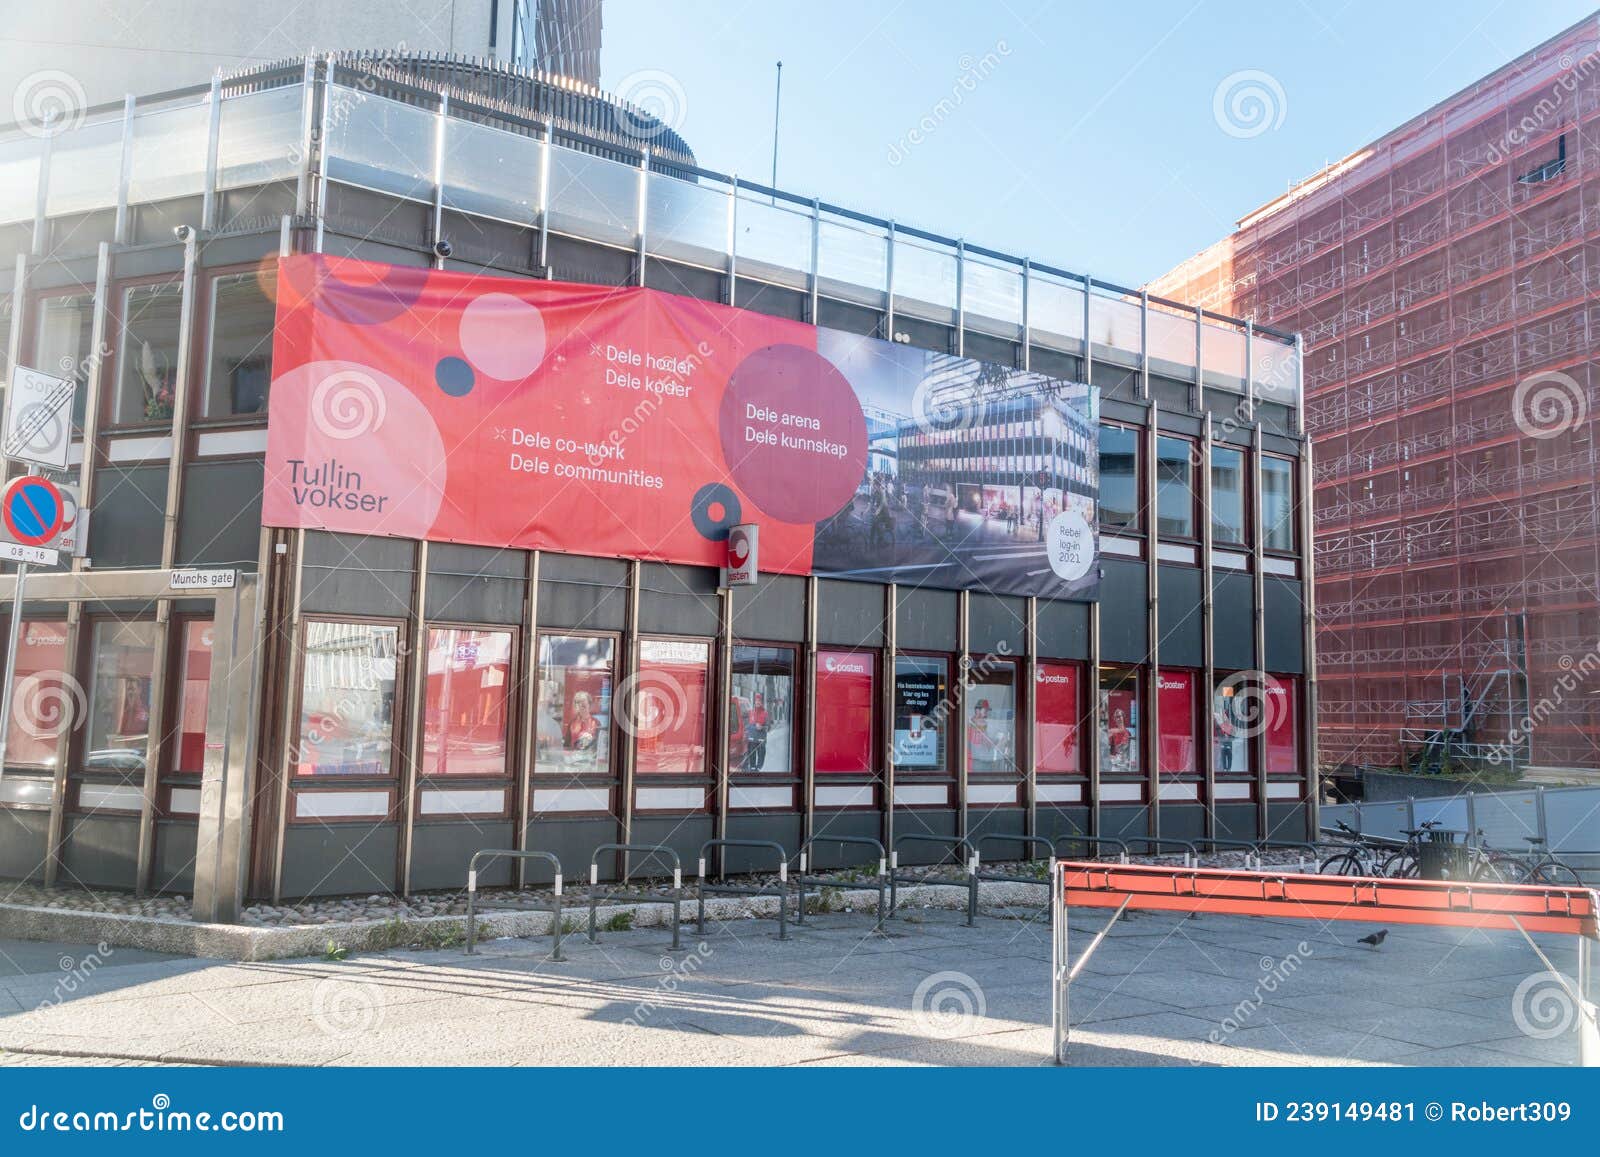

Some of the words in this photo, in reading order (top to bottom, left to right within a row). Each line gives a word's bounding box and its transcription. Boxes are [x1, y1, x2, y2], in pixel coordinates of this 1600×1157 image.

[606, 345, 641, 366] Dele
[605, 368, 641, 390] Dele
[645, 376, 692, 398] koder
[745, 403, 778, 423] Dele
[781, 413, 821, 431] arena
[511, 428, 551, 449] Dele
[555, 438, 625, 460] co-work
[745, 426, 778, 446] Dele
[781, 432, 848, 460] kunnskap
[286, 458, 362, 490] Tullin
[510, 453, 550, 474] Dele
[554, 463, 664, 489] communities
[293, 484, 389, 513] vokser
[1059, 525, 1081, 538] Rebel
[34, 551, 46, 560] 16
[1059, 539, 1081, 552] log-in
[1058, 551, 1081, 564] 2021
[172, 572, 208, 585] Munchs
[211, 573, 233, 586] gate
[836, 663, 864, 673] posten
[1045, 674, 1069, 684] posten
